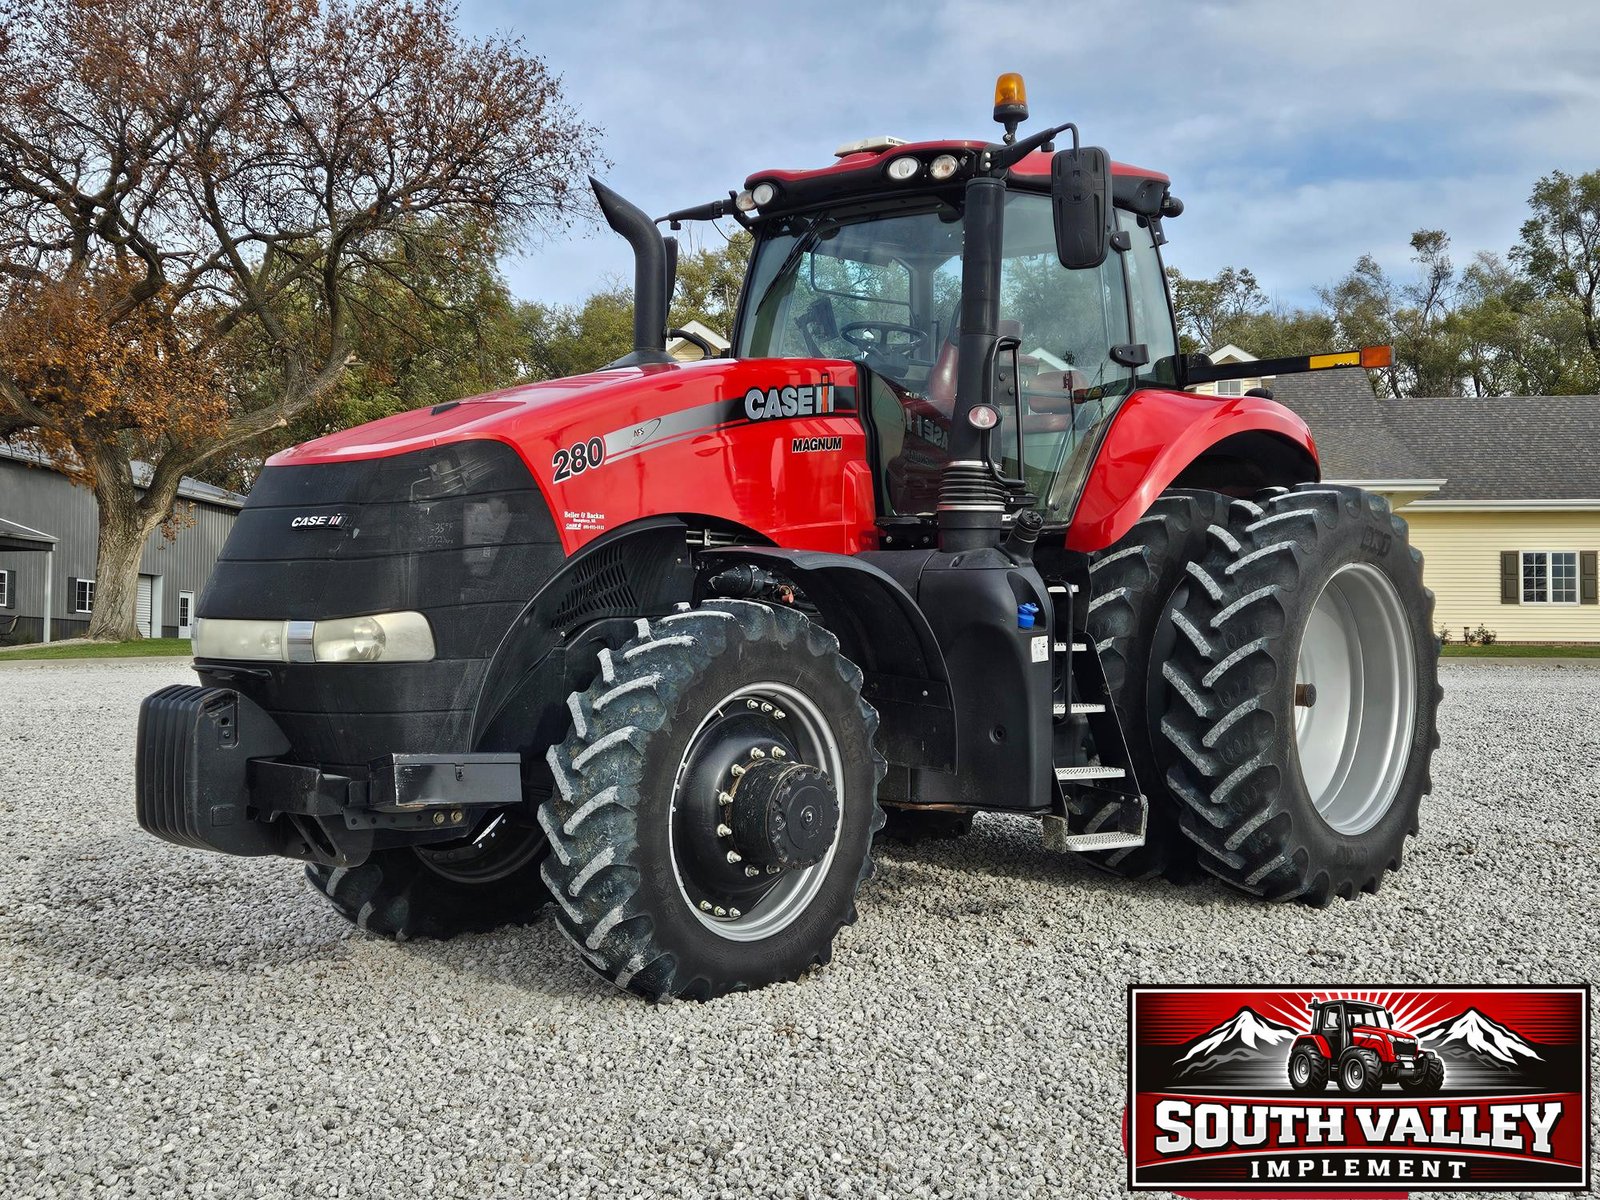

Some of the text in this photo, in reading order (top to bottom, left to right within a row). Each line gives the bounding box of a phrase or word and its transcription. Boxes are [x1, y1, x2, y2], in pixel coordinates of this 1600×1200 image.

[745, 386, 813, 420] CASE
[792, 436, 843, 453] MAGNUM
[552, 436, 604, 485] 280
[291, 516, 328, 528] CASE
